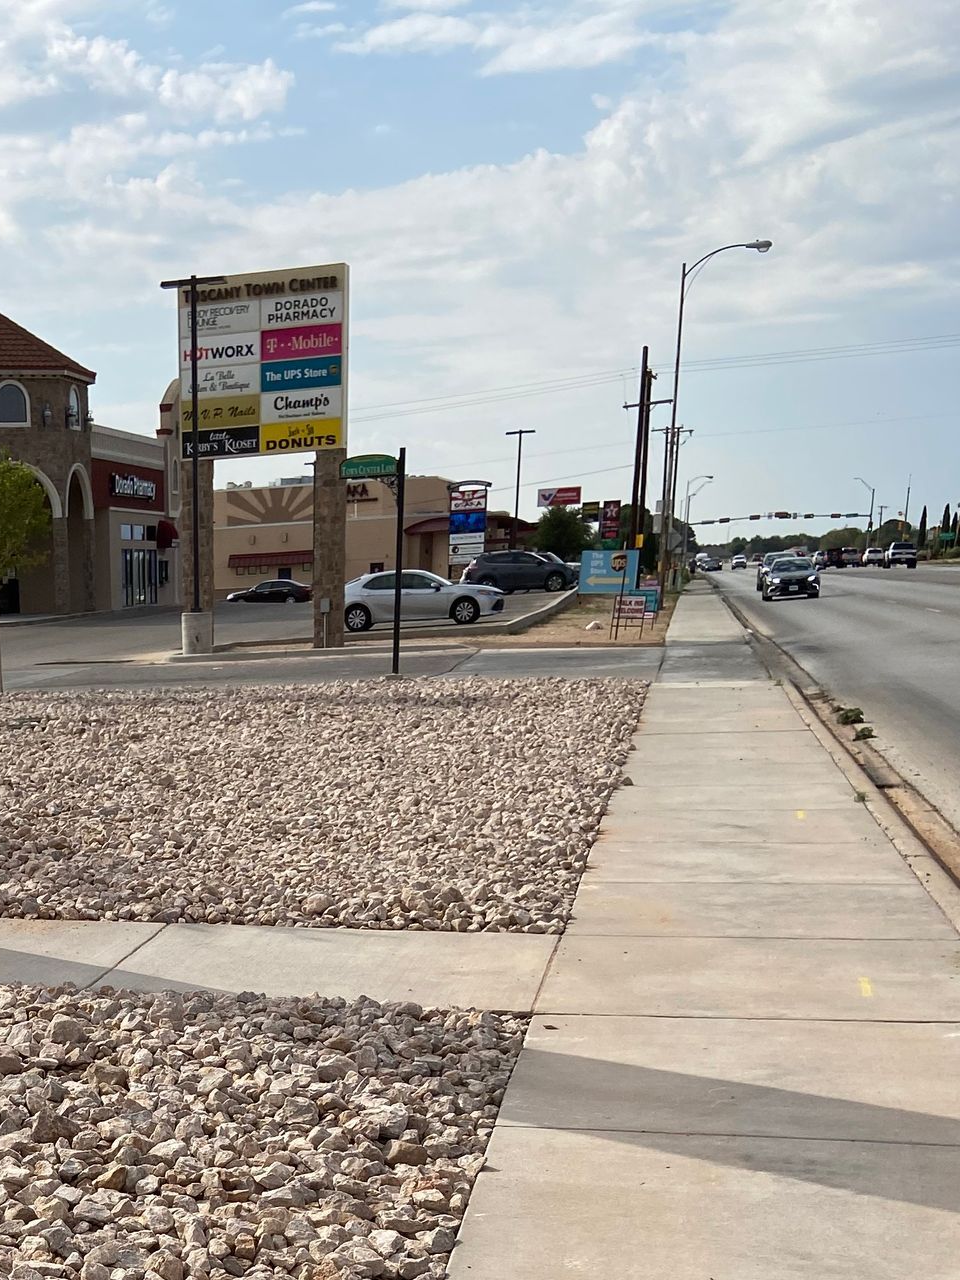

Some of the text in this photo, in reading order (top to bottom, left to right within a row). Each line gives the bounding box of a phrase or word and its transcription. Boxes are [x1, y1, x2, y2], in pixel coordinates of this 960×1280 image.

[244, 281, 285, 297] TOWN
[288, 275, 338, 292] CENTER
[210, 304, 250, 317] RECOVERY
[275, 297, 328, 312] DORADO
[187, 316, 218, 328] LUNGE
[267, 306, 336, 324] PHARMACY
[265, 368, 328, 382] The UPS Store
[273, 393, 330, 411] Champ's
[228, 406, 256, 418] Nails
[185, 439, 257, 455] KRBY'S KLOSET
[266, 434, 336, 451] DONUTS
